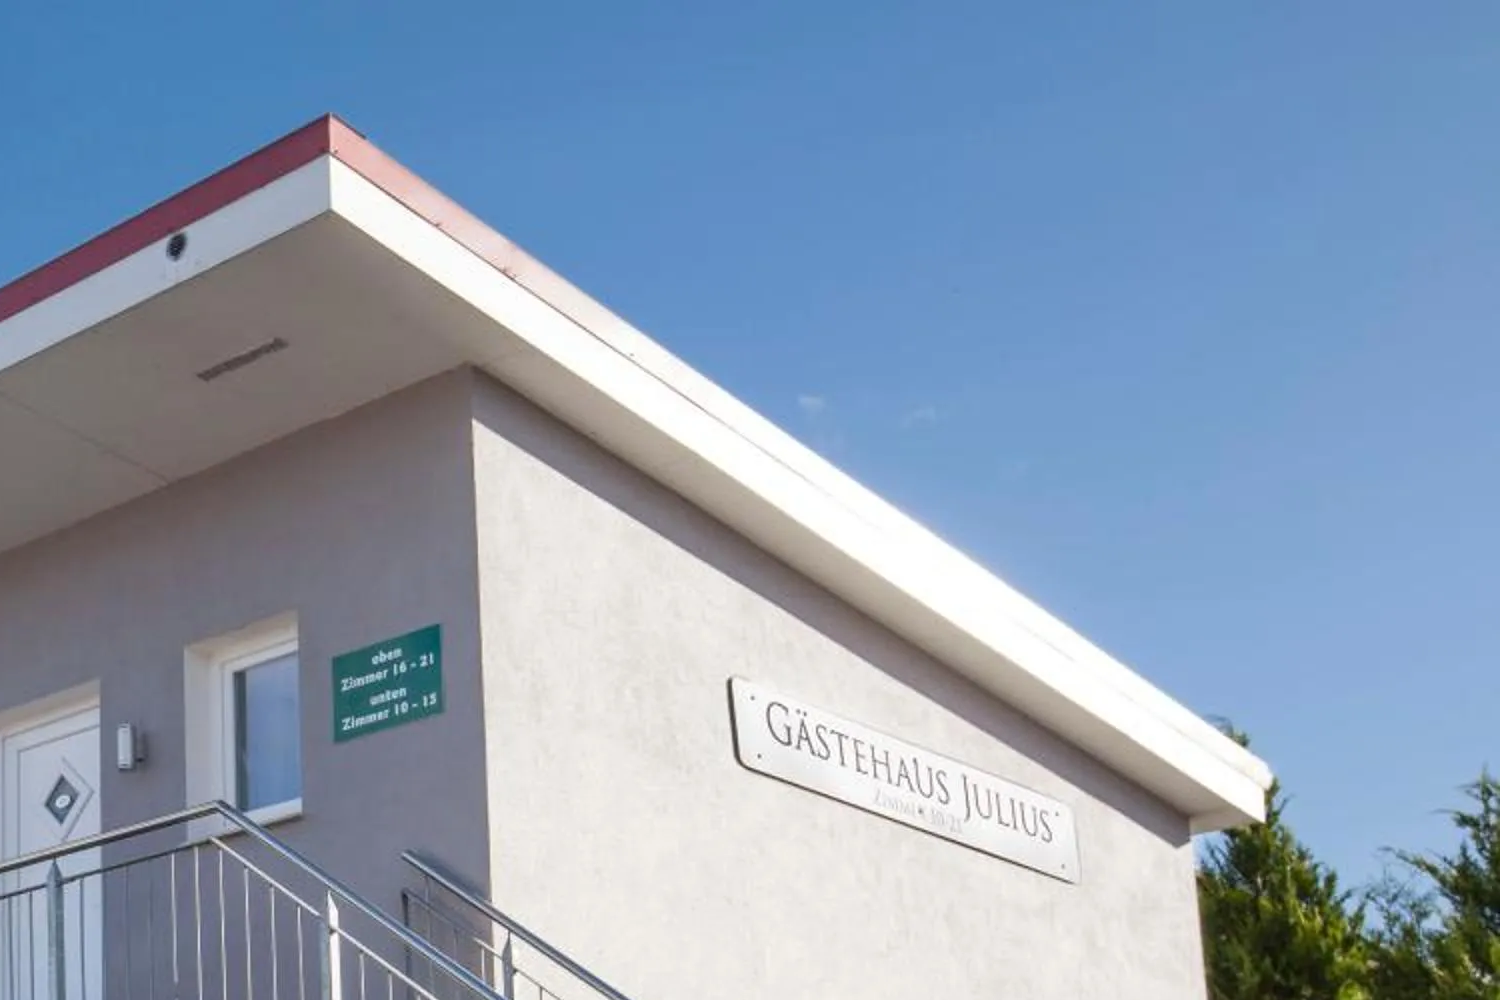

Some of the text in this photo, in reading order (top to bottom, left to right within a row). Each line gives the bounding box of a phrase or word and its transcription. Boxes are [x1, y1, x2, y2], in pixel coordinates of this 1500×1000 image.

[340, 669, 389, 692] Zimmer
[393, 661, 407, 677] 16
[419, 652, 435, 668] 21
[371, 648, 403, 665] oben
[341, 709, 390, 731] Zimmer
[394, 701, 409, 716] 10
[422, 692, 437, 708] 15
[369, 687, 407, 706] unten
[765, 701, 951, 805] GÄSTEHAUS
[961, 773, 1053, 843] JULIUS
